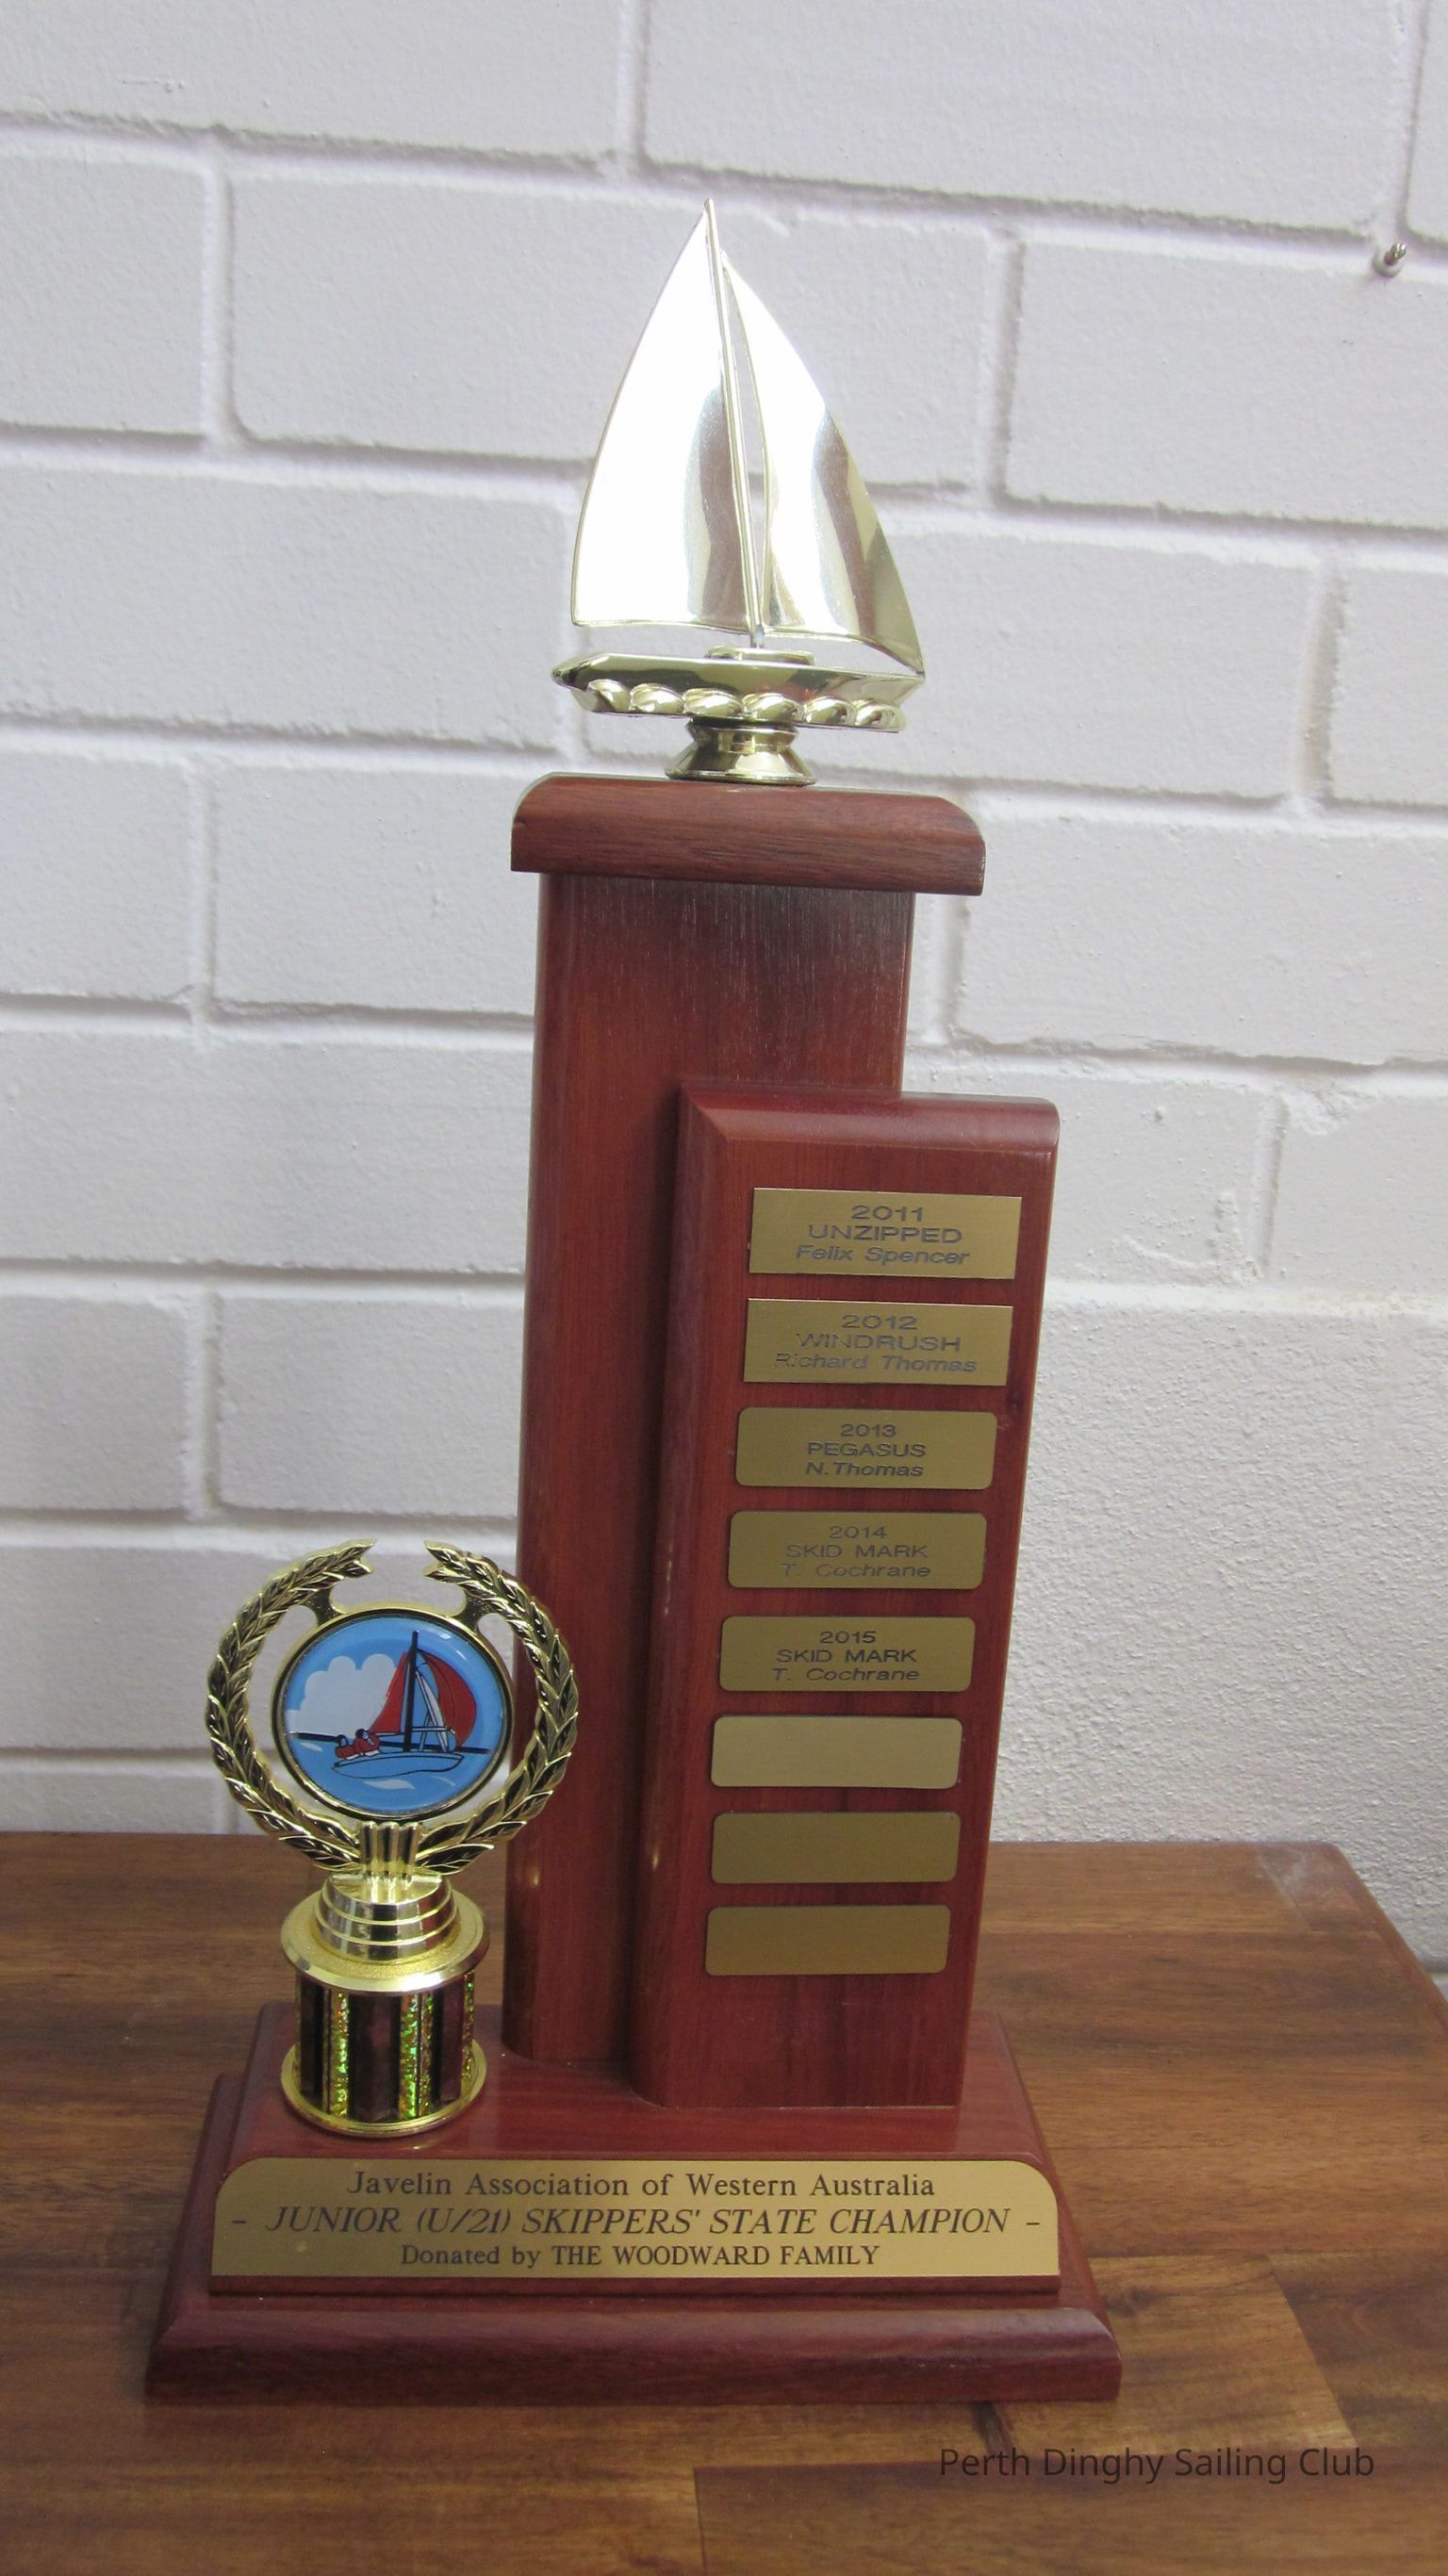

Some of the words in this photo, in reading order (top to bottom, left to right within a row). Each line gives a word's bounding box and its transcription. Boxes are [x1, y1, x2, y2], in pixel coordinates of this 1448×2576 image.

[851, 1205, 924, 1222] 2011
[809, 1224, 963, 1243] UNZIPPED
[796, 1245, 853, 1261] Felix
[865, 1247, 970, 1265] Spencer
[842, 1315, 917, 1330] 2012
[796, 1333, 962, 1351] WINDRUSH
[774, 1353, 868, 1369] Richard
[882, 1354, 978, 1372] Thomas
[840, 1423, 897, 1437] 2013
[807, 1442, 927, 1457] PEGASUS
[829, 1525, 887, 1539] 2014
[785, 1544, 842, 1558] SKID
[855, 1545, 928, 1558] MARK
[781, 1563, 799, 1577] T.
[815, 1563, 931, 1578] Cochrane
[819, 1631, 877, 1644] 2015
[776, 1649, 832, 1663] SKID
[845, 1649, 916, 1663] MARK
[772, 1667, 791, 1682] T.
[806, 1667, 920, 1682] Cochrane
[347, 2171, 452, 2195] Javelin
[465, 2173, 629, 2196] Association
[641, 2174, 674, 2196] of
[687, 2174, 797, 2196] Western
[810, 2174, 935, 2196] Australia
[265, 2207, 402, 2234] JUNIOR
[417, 2207, 512, 2234] (U/21)
[521, 2207, 699, 2234] SKIPPERS'
[709, 2208, 817, 2234] STATE
[829, 2208, 1011, 2234] CHAMPION
[402, 2244, 500, 2265] Donated
[512, 2245, 542, 2268] by
[551, 2246, 602, 2265] THE
[612, 2245, 770, 2265] WOODWARD
[780, 2245, 880, 2265] FAMILY
